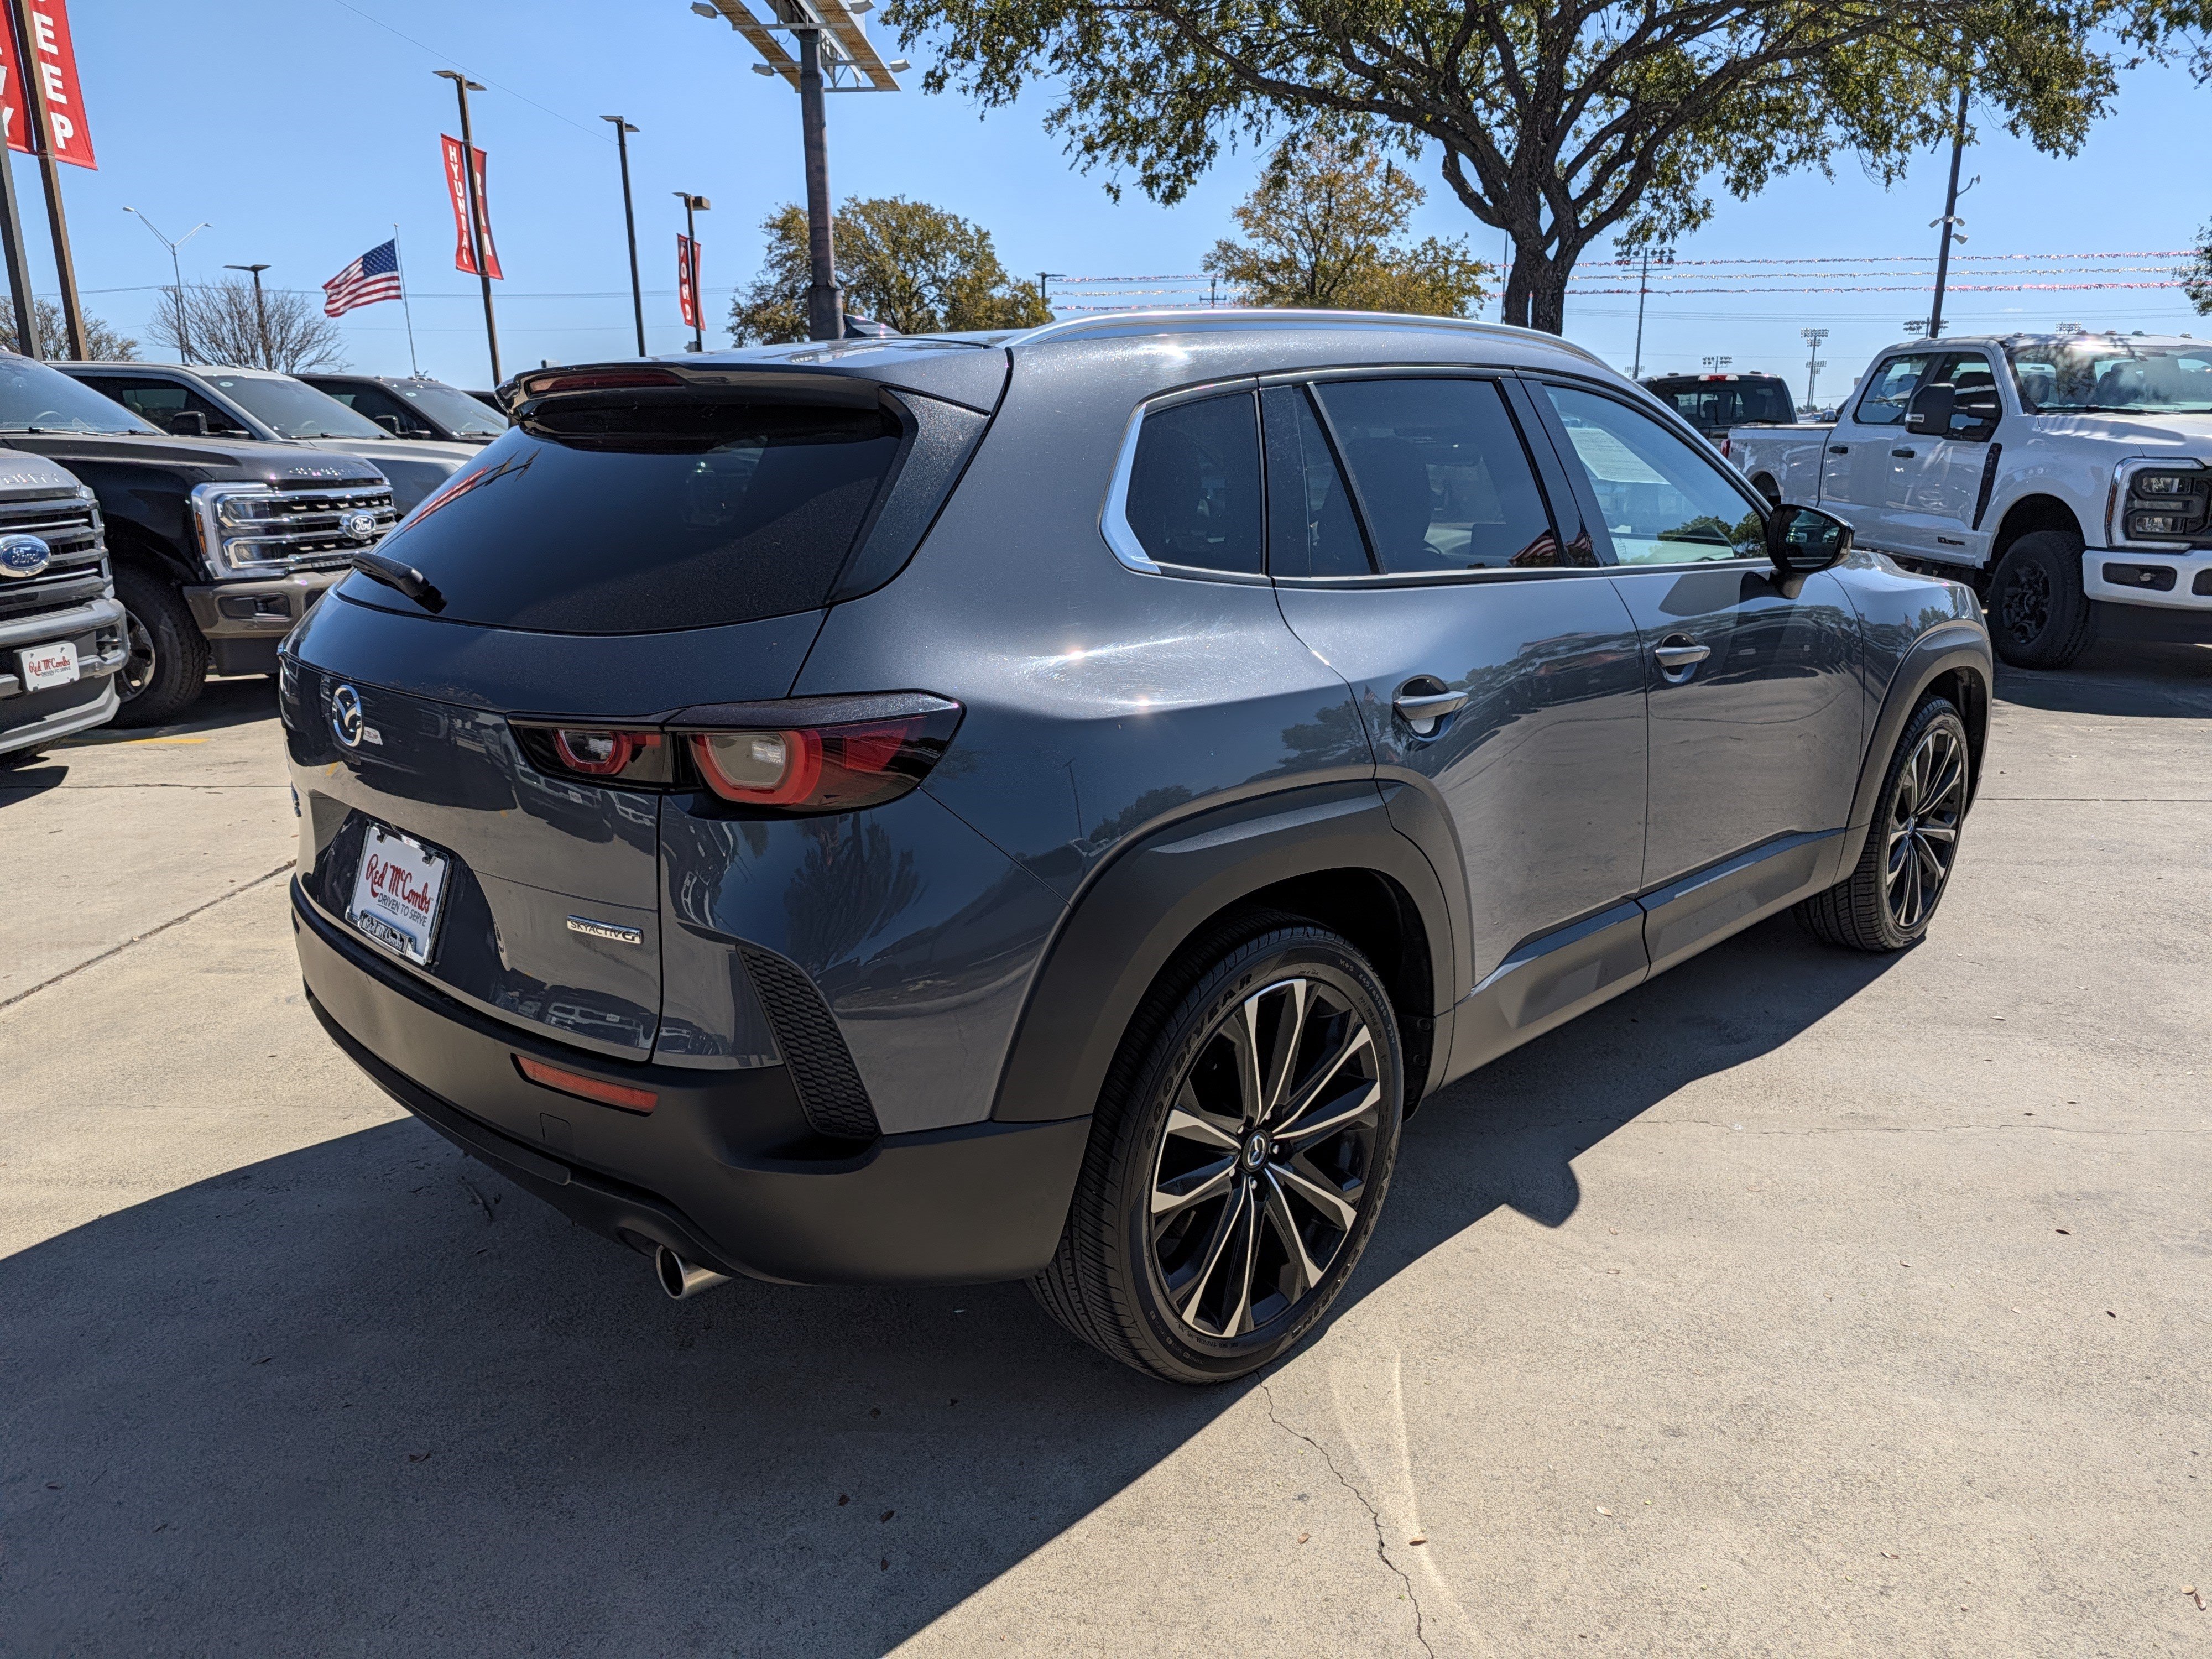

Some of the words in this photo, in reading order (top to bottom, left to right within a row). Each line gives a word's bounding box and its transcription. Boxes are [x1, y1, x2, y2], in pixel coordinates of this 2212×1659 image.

[32, 0, 74, 149] EEP
[448, 145, 468, 265] HYUNDAI
[356, 518, 372, 531] Ford
[12, 546, 40, 565] Ford
[29, 661, 42, 676] Red
[41, 656, 70, 670] McCombs
[366, 854, 388, 898] Red
[389, 863, 430, 914] McCombs
[378, 893, 400, 912] DRIVEN
[401, 902, 410, 917] TO
[409, 909, 427, 927] SERVE
[365, 916, 378, 934] Red
[378, 923, 404, 950] McCombs
[1358, 973, 1387, 1017] 245/45R20
[1145, 973, 1252, 1150] GOODYEAR
